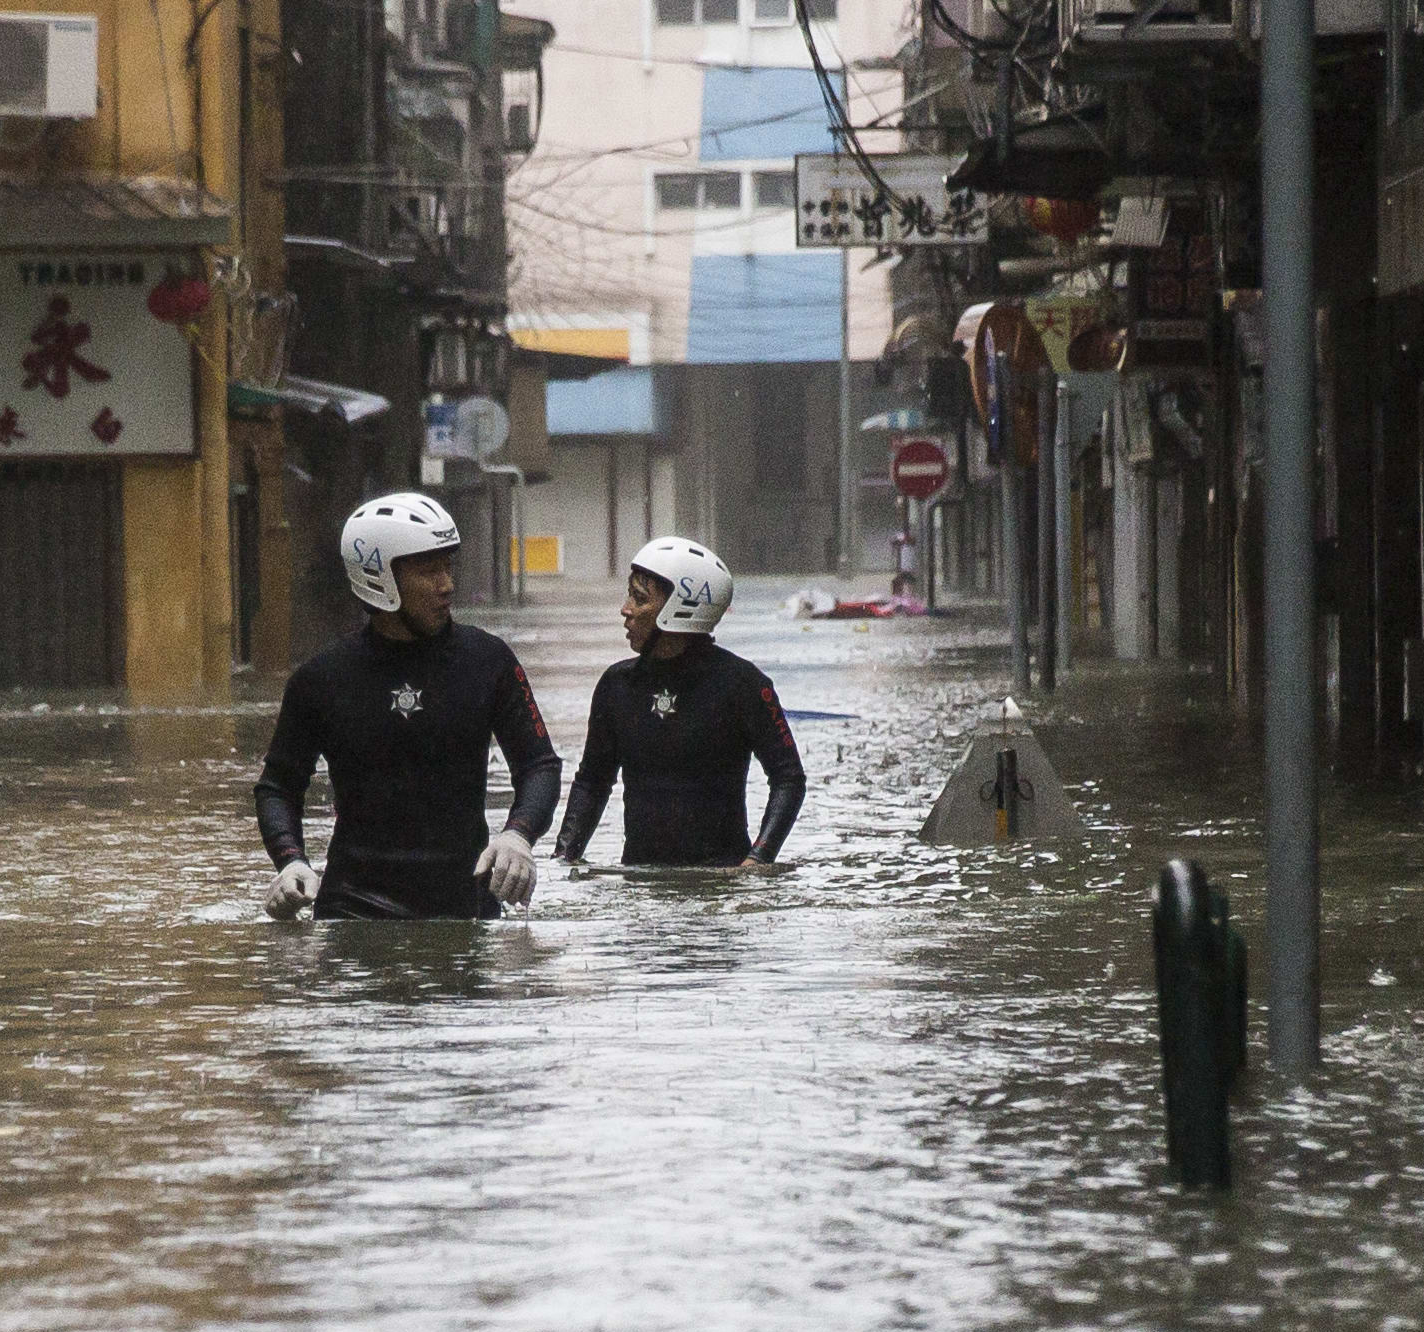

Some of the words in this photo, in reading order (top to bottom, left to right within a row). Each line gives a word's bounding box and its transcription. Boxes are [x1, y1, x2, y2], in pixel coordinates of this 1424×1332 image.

[20, 263, 145, 284] TRADING
[353, 537, 384, 572] SA
[677, 576, 712, 605] SA
